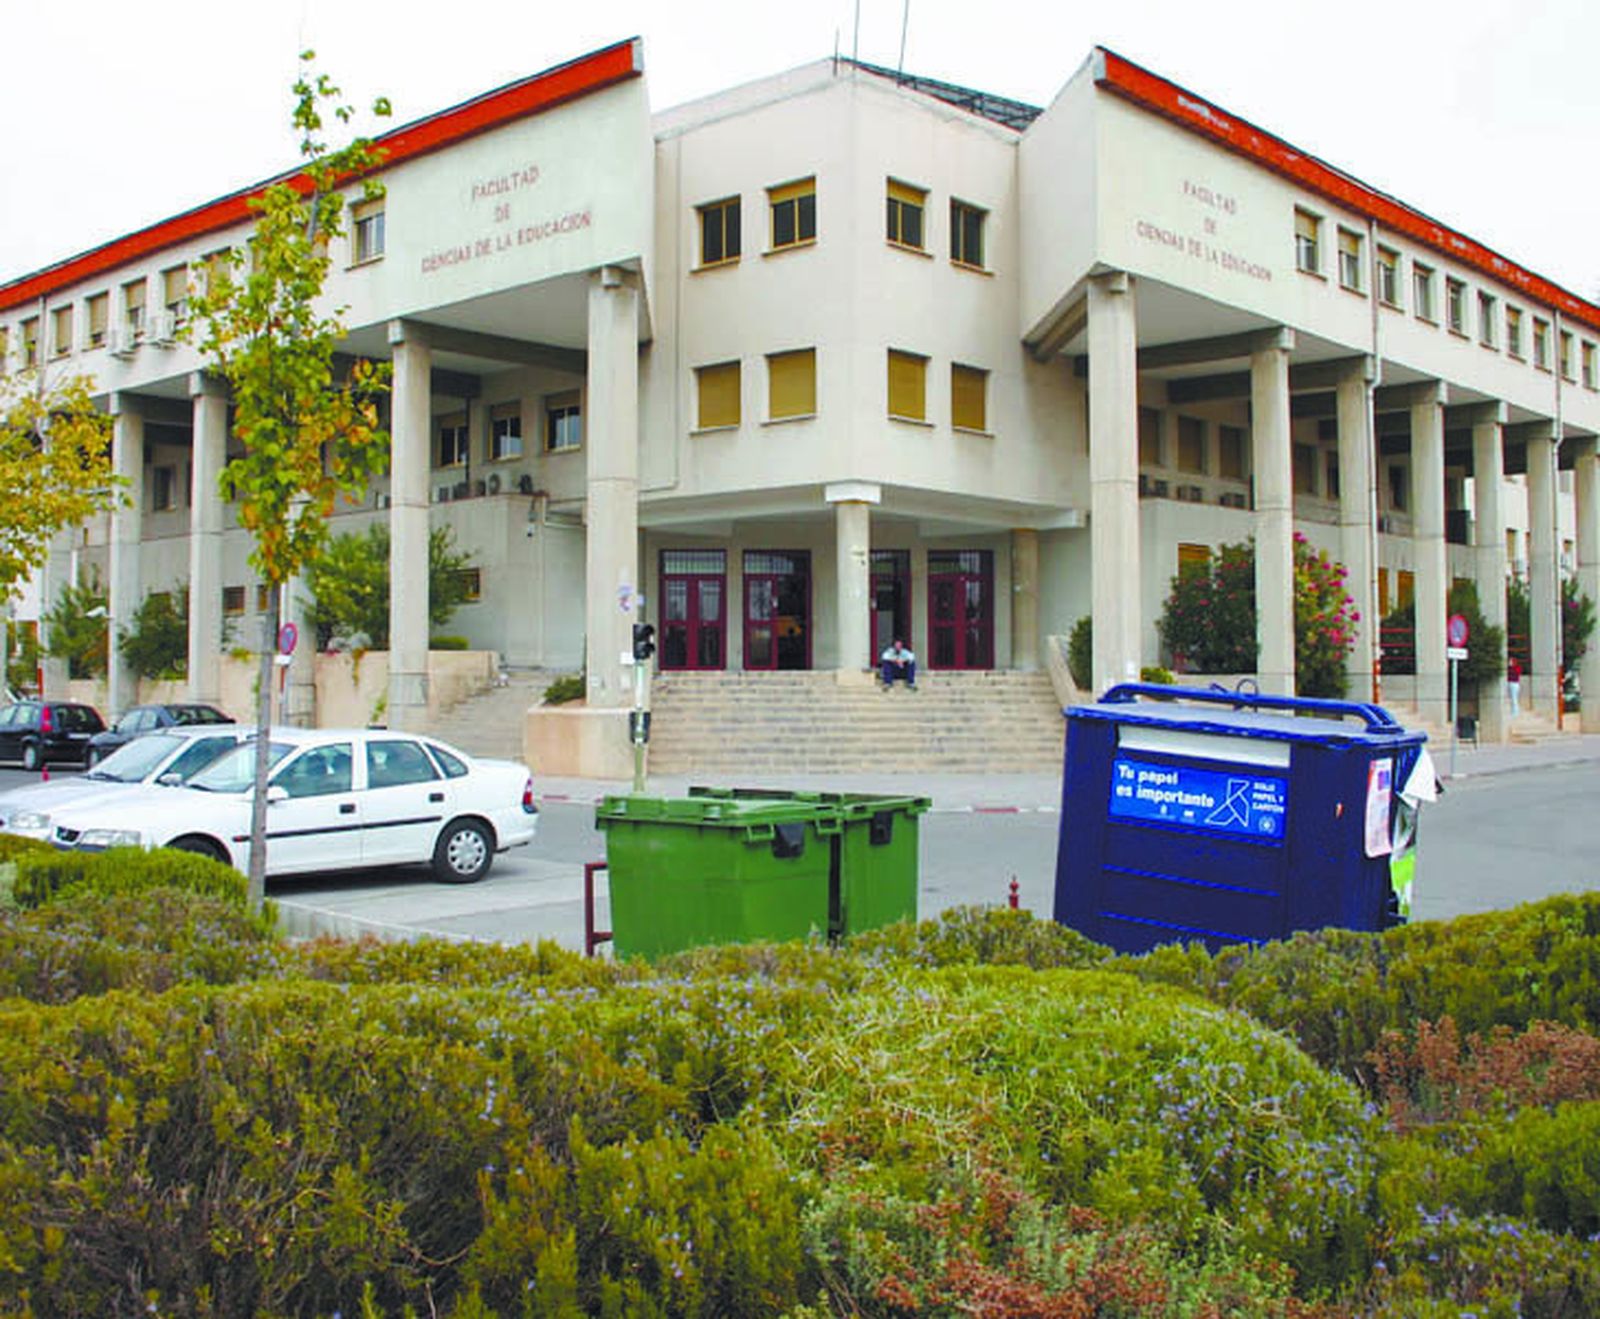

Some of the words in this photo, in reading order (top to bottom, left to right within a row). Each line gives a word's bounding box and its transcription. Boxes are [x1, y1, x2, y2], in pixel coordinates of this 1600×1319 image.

[471, 166, 539, 200] FACULTAD
[1184, 181, 1237, 214] FACULTAD
[495, 203, 510, 222] DE
[1204, 218, 1216, 235] DE
[422, 246, 471, 272] CIENCIAS
[475, 238, 492, 257] DE
[497, 234, 512, 250] LA
[1138, 221, 1184, 251] CIENCIAS
[1188, 239, 1201, 258] DE
[1206, 247, 1218, 264] LA
[1118, 765, 1134, 779] Tu
[1138, 769, 1178, 785] papel
[1116, 786, 1132, 796] es
[1137, 785, 1214, 807] importante
